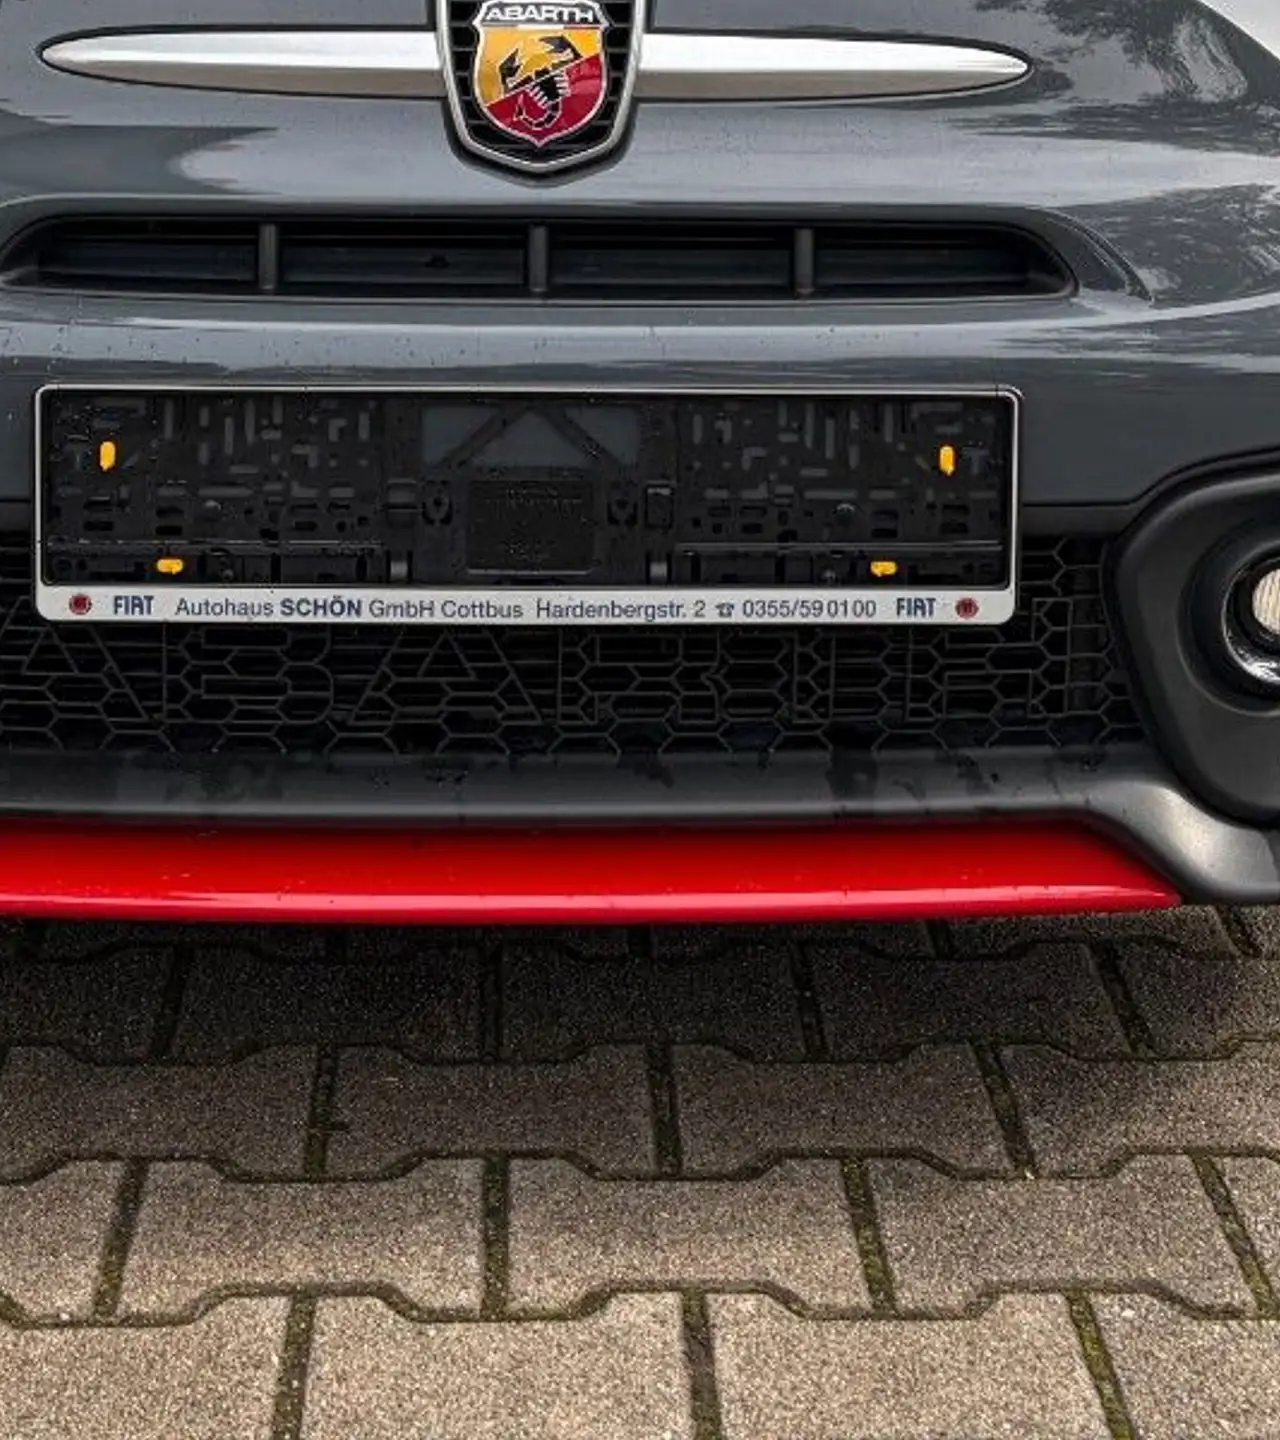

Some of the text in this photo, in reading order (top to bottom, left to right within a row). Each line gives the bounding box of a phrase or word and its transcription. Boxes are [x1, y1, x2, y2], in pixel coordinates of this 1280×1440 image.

[486, 5, 594, 23] ABARTH
[113, 595, 155, 616] FIAT
[174, 597, 274, 618] Autohaus
[279, 596, 362, 618] SCHÖN
[368, 599, 435, 618] GmbH
[440, 600, 524, 619] Cottbus
[536, 598, 686, 622] Hardenbergstr.
[694, 599, 706, 618] 2
[896, 597, 937, 618] FIAT
